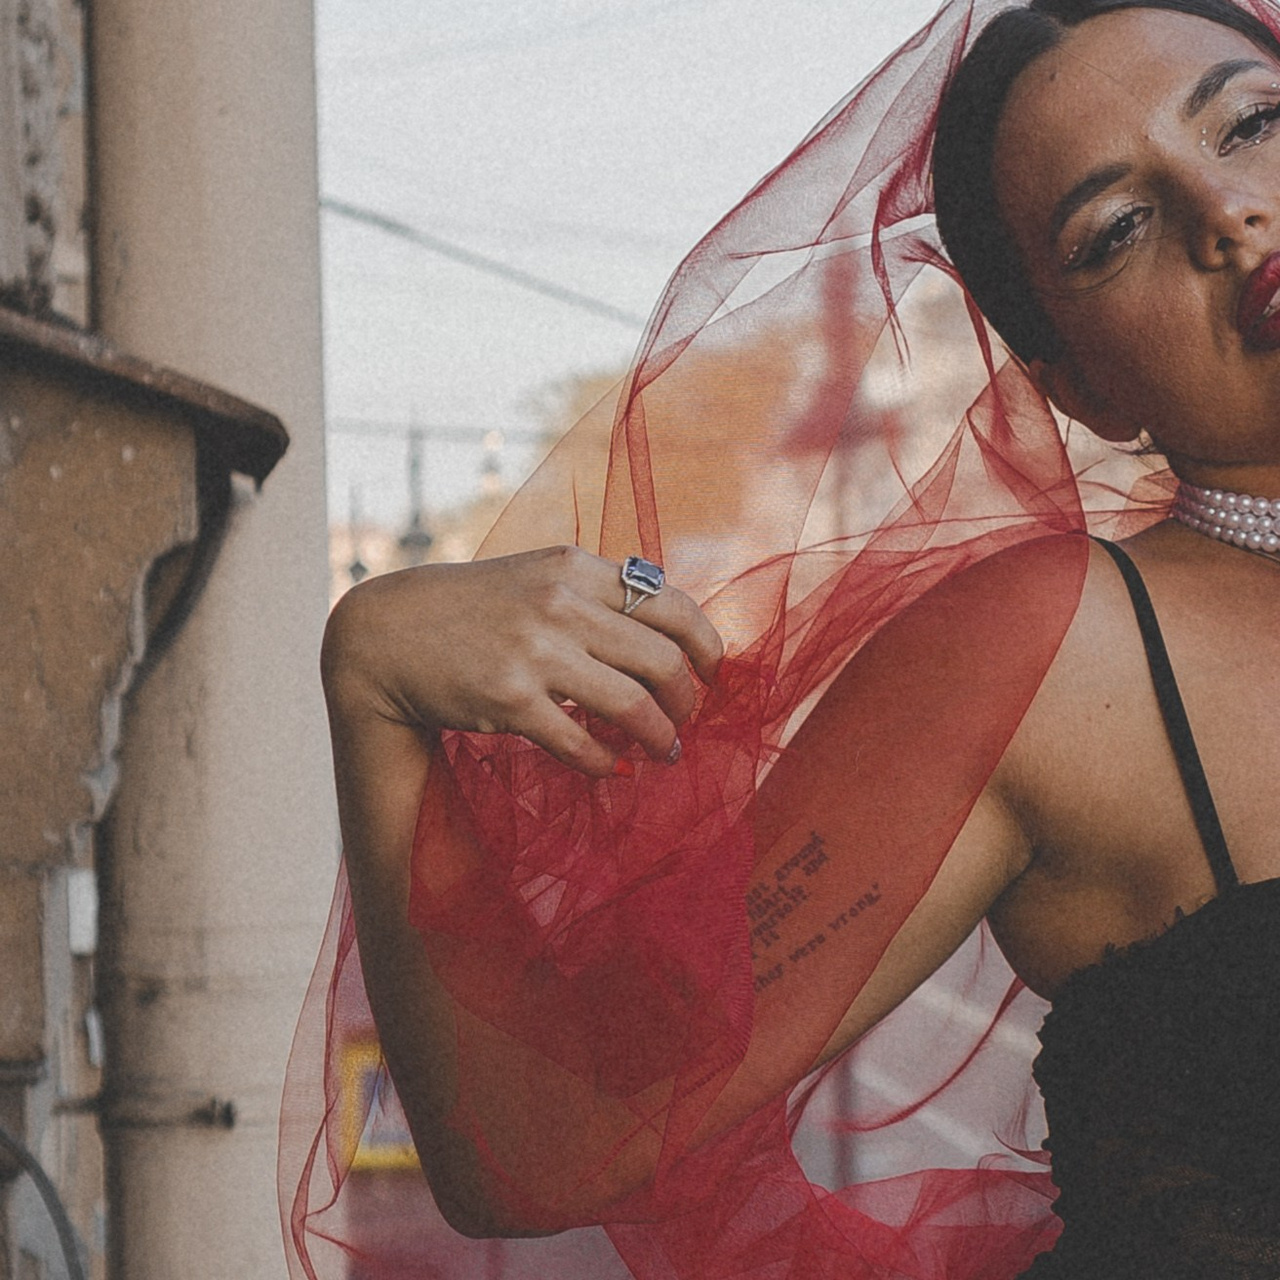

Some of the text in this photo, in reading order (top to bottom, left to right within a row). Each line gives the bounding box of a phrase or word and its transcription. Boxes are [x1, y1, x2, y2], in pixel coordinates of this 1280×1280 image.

[774, 830, 826, 882] around
[802, 850, 830, 876] and
[760, 929, 781, 949] it
[788, 932, 827, 963] were
